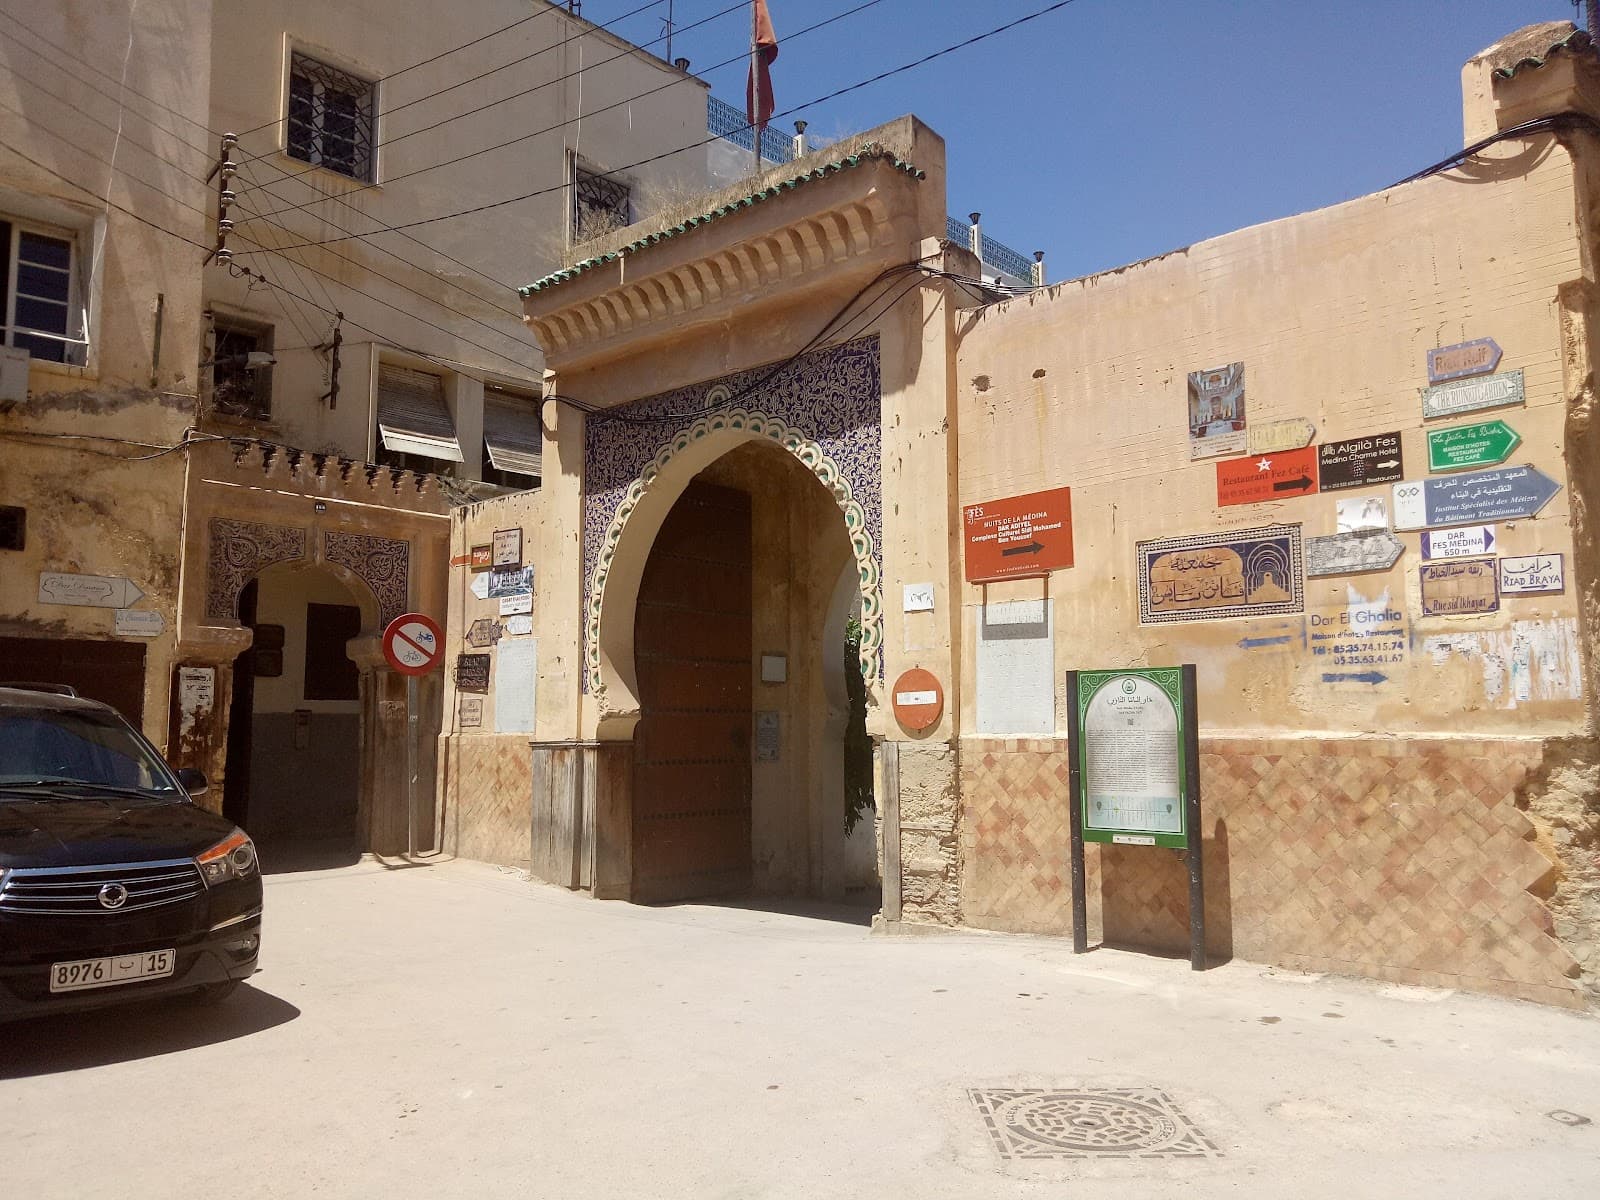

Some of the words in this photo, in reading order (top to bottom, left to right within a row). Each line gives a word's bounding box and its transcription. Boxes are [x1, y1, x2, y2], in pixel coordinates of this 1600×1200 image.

[1338, 440, 1372, 453] Algilà
[1376, 438, 1397, 447] Fes
[1321, 457, 1348, 465] Medina
[1349, 451, 1378, 461] Charme
[1379, 447, 1398, 455] Hotel
[1223, 472, 1268, 485] Restaurant
[1463, 472, 1500, 487] المتخصص
[1504, 469, 1528, 480] المعهد
[1435, 505, 1460, 513] Institut
[1510, 495, 1537, 504] Métiers
[1478, 506, 1525, 518] Traditionnels
[984, 520, 1002, 528] NUITS
[1033, 521, 1062, 532] Mohamed
[1447, 531, 1465, 540] DAR
[1433, 541, 1447, 549] FES
[1449, 537, 1483, 548] MEDINA
[1503, 576, 1526, 587] RIAD
[1529, 574, 1561, 585] BRAYA
[1433, 598, 1446, 610] Rue
[1311, 614, 1335, 626] Dar
[1340, 611, 1350, 624] El
[1355, 608, 1402, 623] Ghalia
[57, 961, 104, 984] 8976
[147, 953, 167, 972] 15
